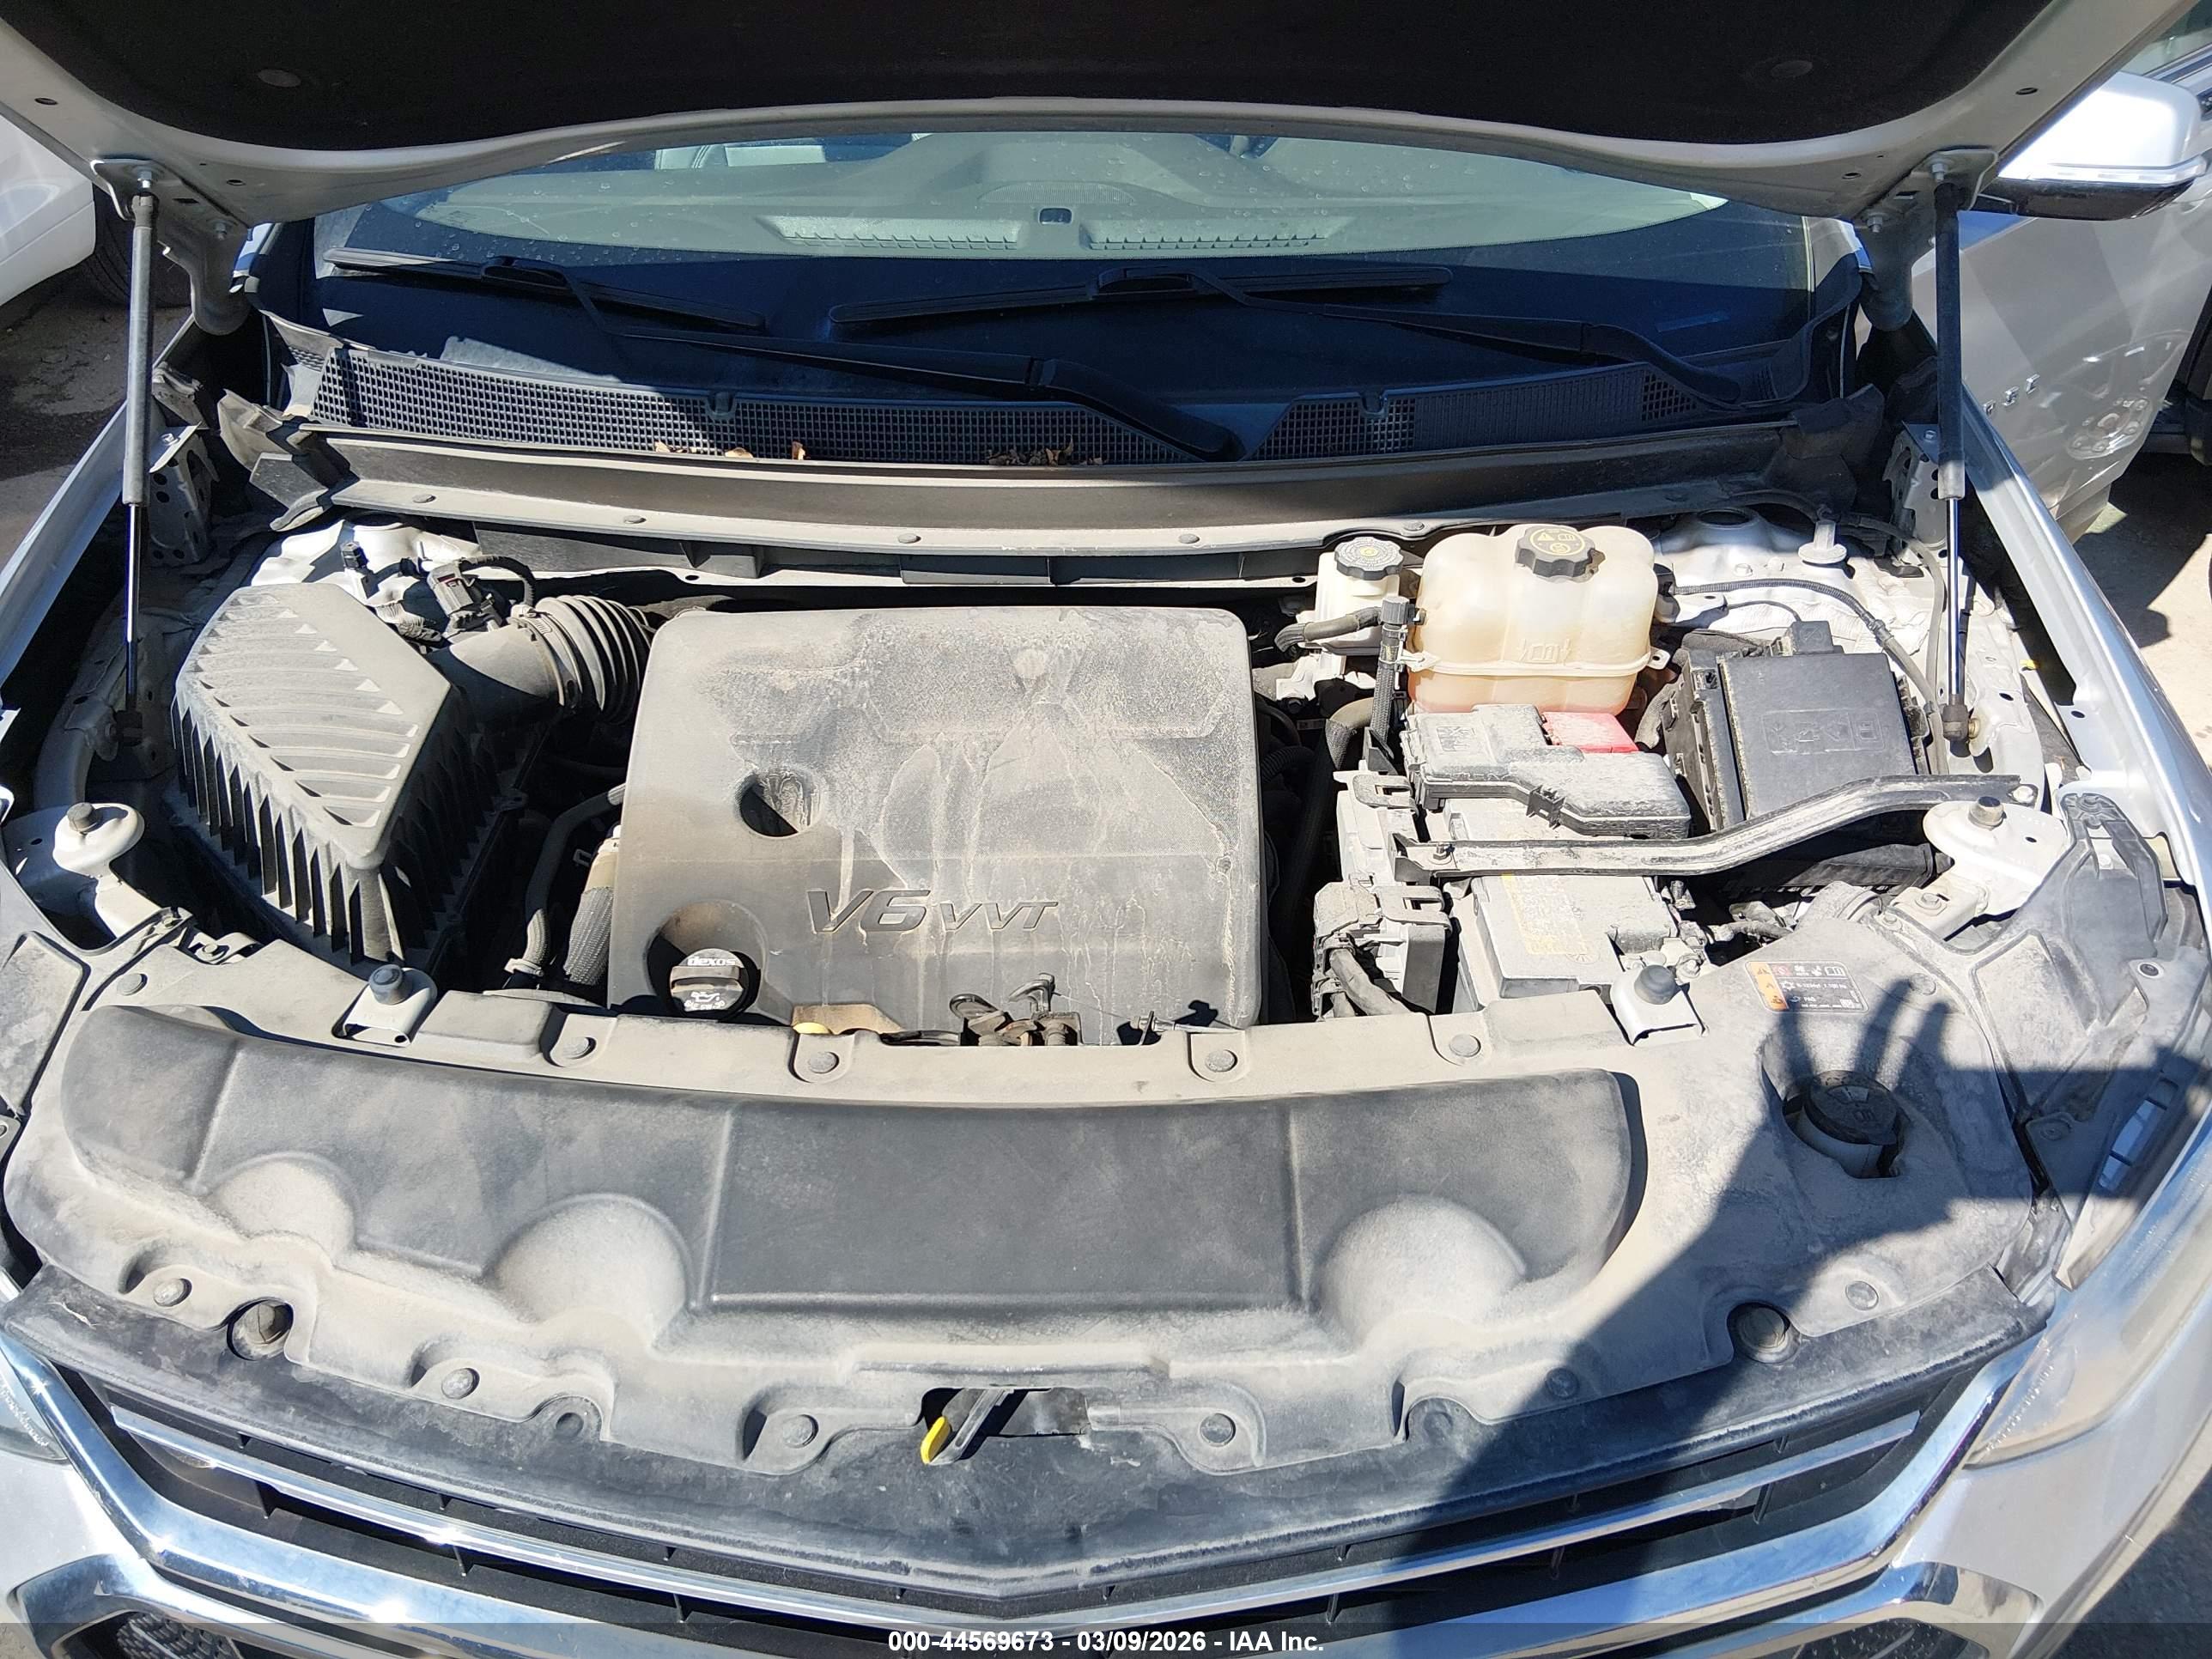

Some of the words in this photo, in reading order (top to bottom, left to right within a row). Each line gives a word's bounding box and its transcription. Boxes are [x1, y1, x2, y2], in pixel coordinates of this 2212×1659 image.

[806, 890, 931, 933] V6
[940, 902, 1059, 931] VVT
[687, 957, 736, 967] dexos
